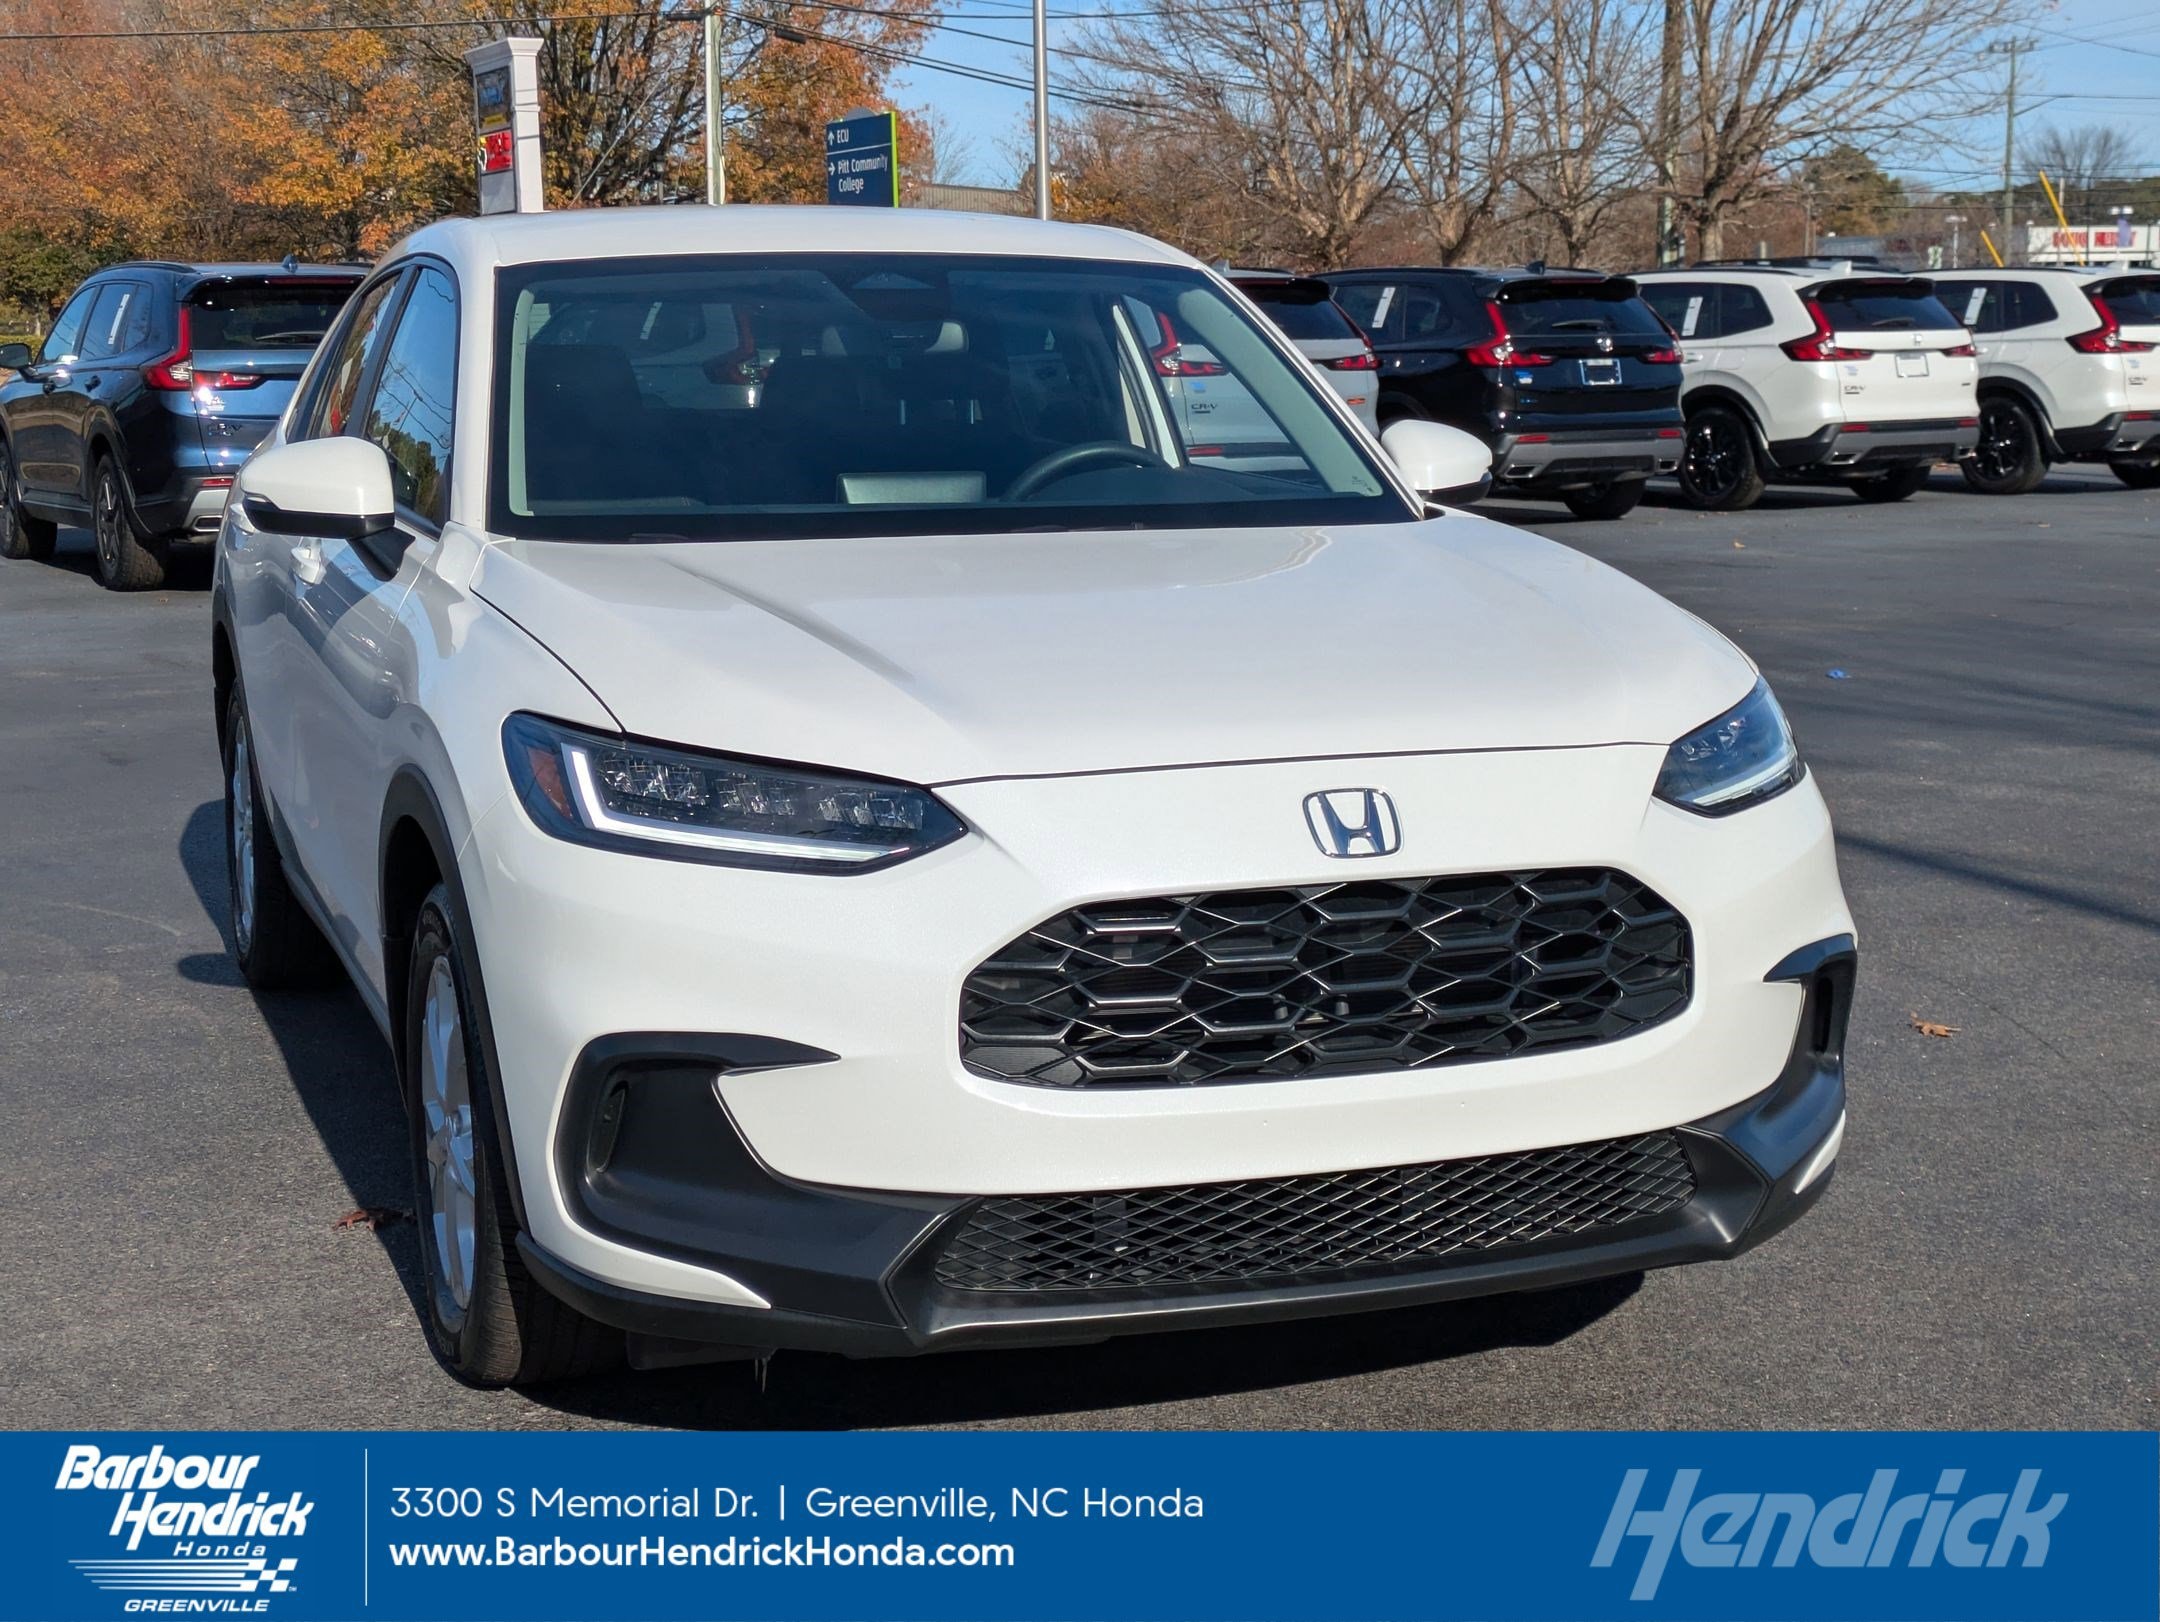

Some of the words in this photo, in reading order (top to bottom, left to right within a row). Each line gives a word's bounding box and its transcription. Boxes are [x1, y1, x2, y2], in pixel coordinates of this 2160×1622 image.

[837, 129, 849, 143] ECU
[838, 159, 850, 174] Pitt
[851, 154, 888, 172] Community
[838, 177, 864, 194] College
